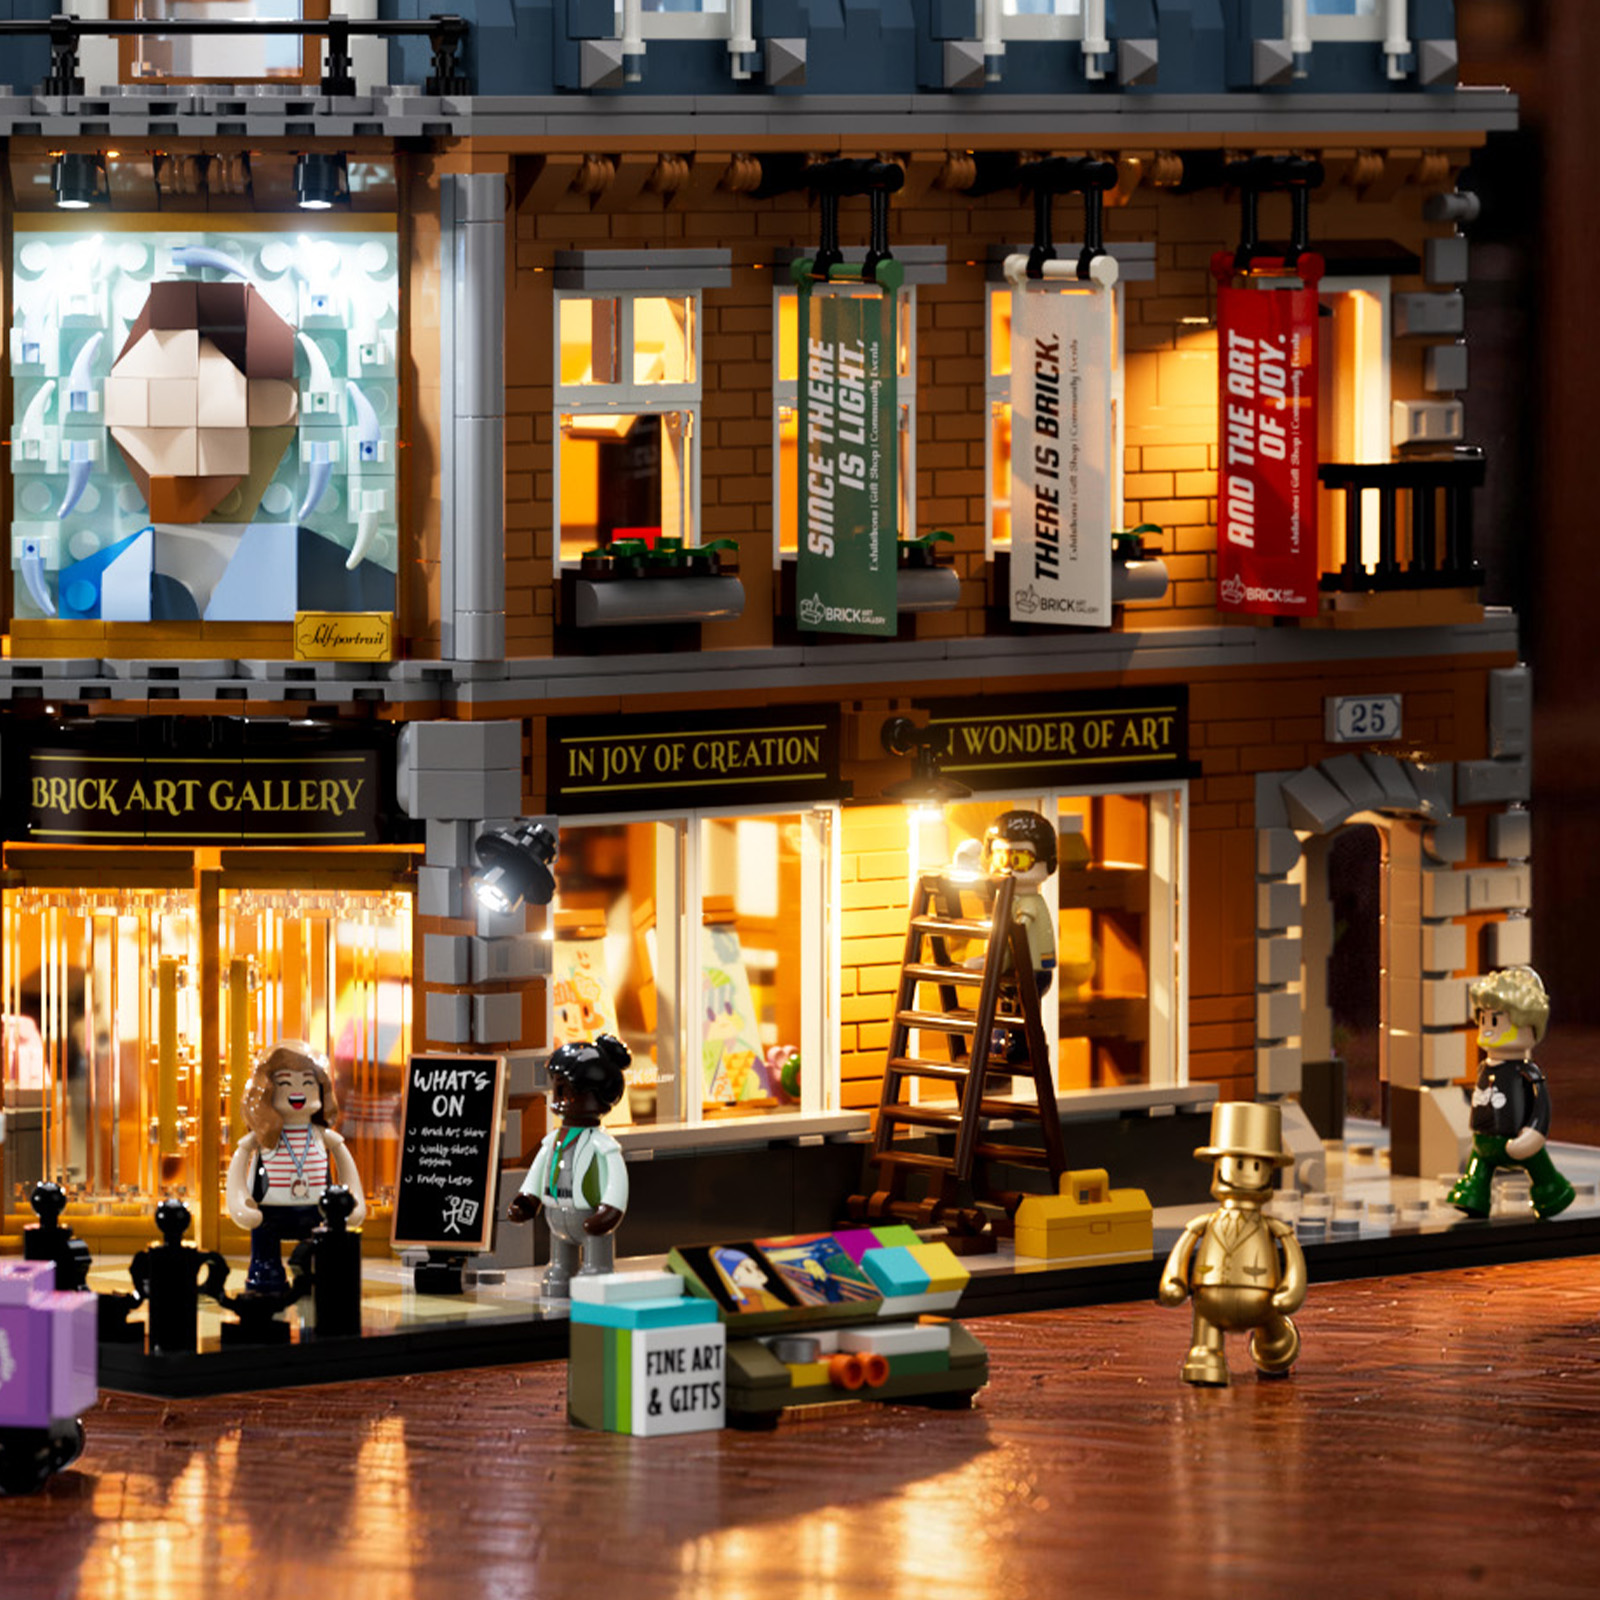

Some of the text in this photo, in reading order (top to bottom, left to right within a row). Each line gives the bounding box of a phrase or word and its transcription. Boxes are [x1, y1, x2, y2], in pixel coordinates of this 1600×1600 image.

[838, 339, 866, 491] IS LIGHT,
[869, 380, 882, 442] Community
[1258, 333, 1287, 461] OF JOY.
[807, 337, 835, 559] SINCE THERE
[1227, 328, 1255, 549] AND THE ART
[1290, 438, 1302, 466] Shop
[869, 450, 881, 480] Shop
[1034, 333, 1060, 581] THERE IS BRICK,
[1040, 597, 1076, 613] BRICK
[1246, 587, 1283, 603] BRICK
[825, 607, 861, 623] BRICK
[961, 720, 1078, 756] WONDER
[1082, 719, 1116, 749] OF
[1120, 716, 1175, 750] ART
[1351, 703, 1385, 734] 25
[568, 735, 821, 782] IN JOY OF CREATION
[31, 776, 366, 817] BRICK ART GALLERY
[413, 1069, 491, 1092] WHAT'S
[431, 1094, 466, 1118] ON
[646, 1344, 723, 1377] FINE ART
[647, 1381, 722, 1417] & GIFTS
